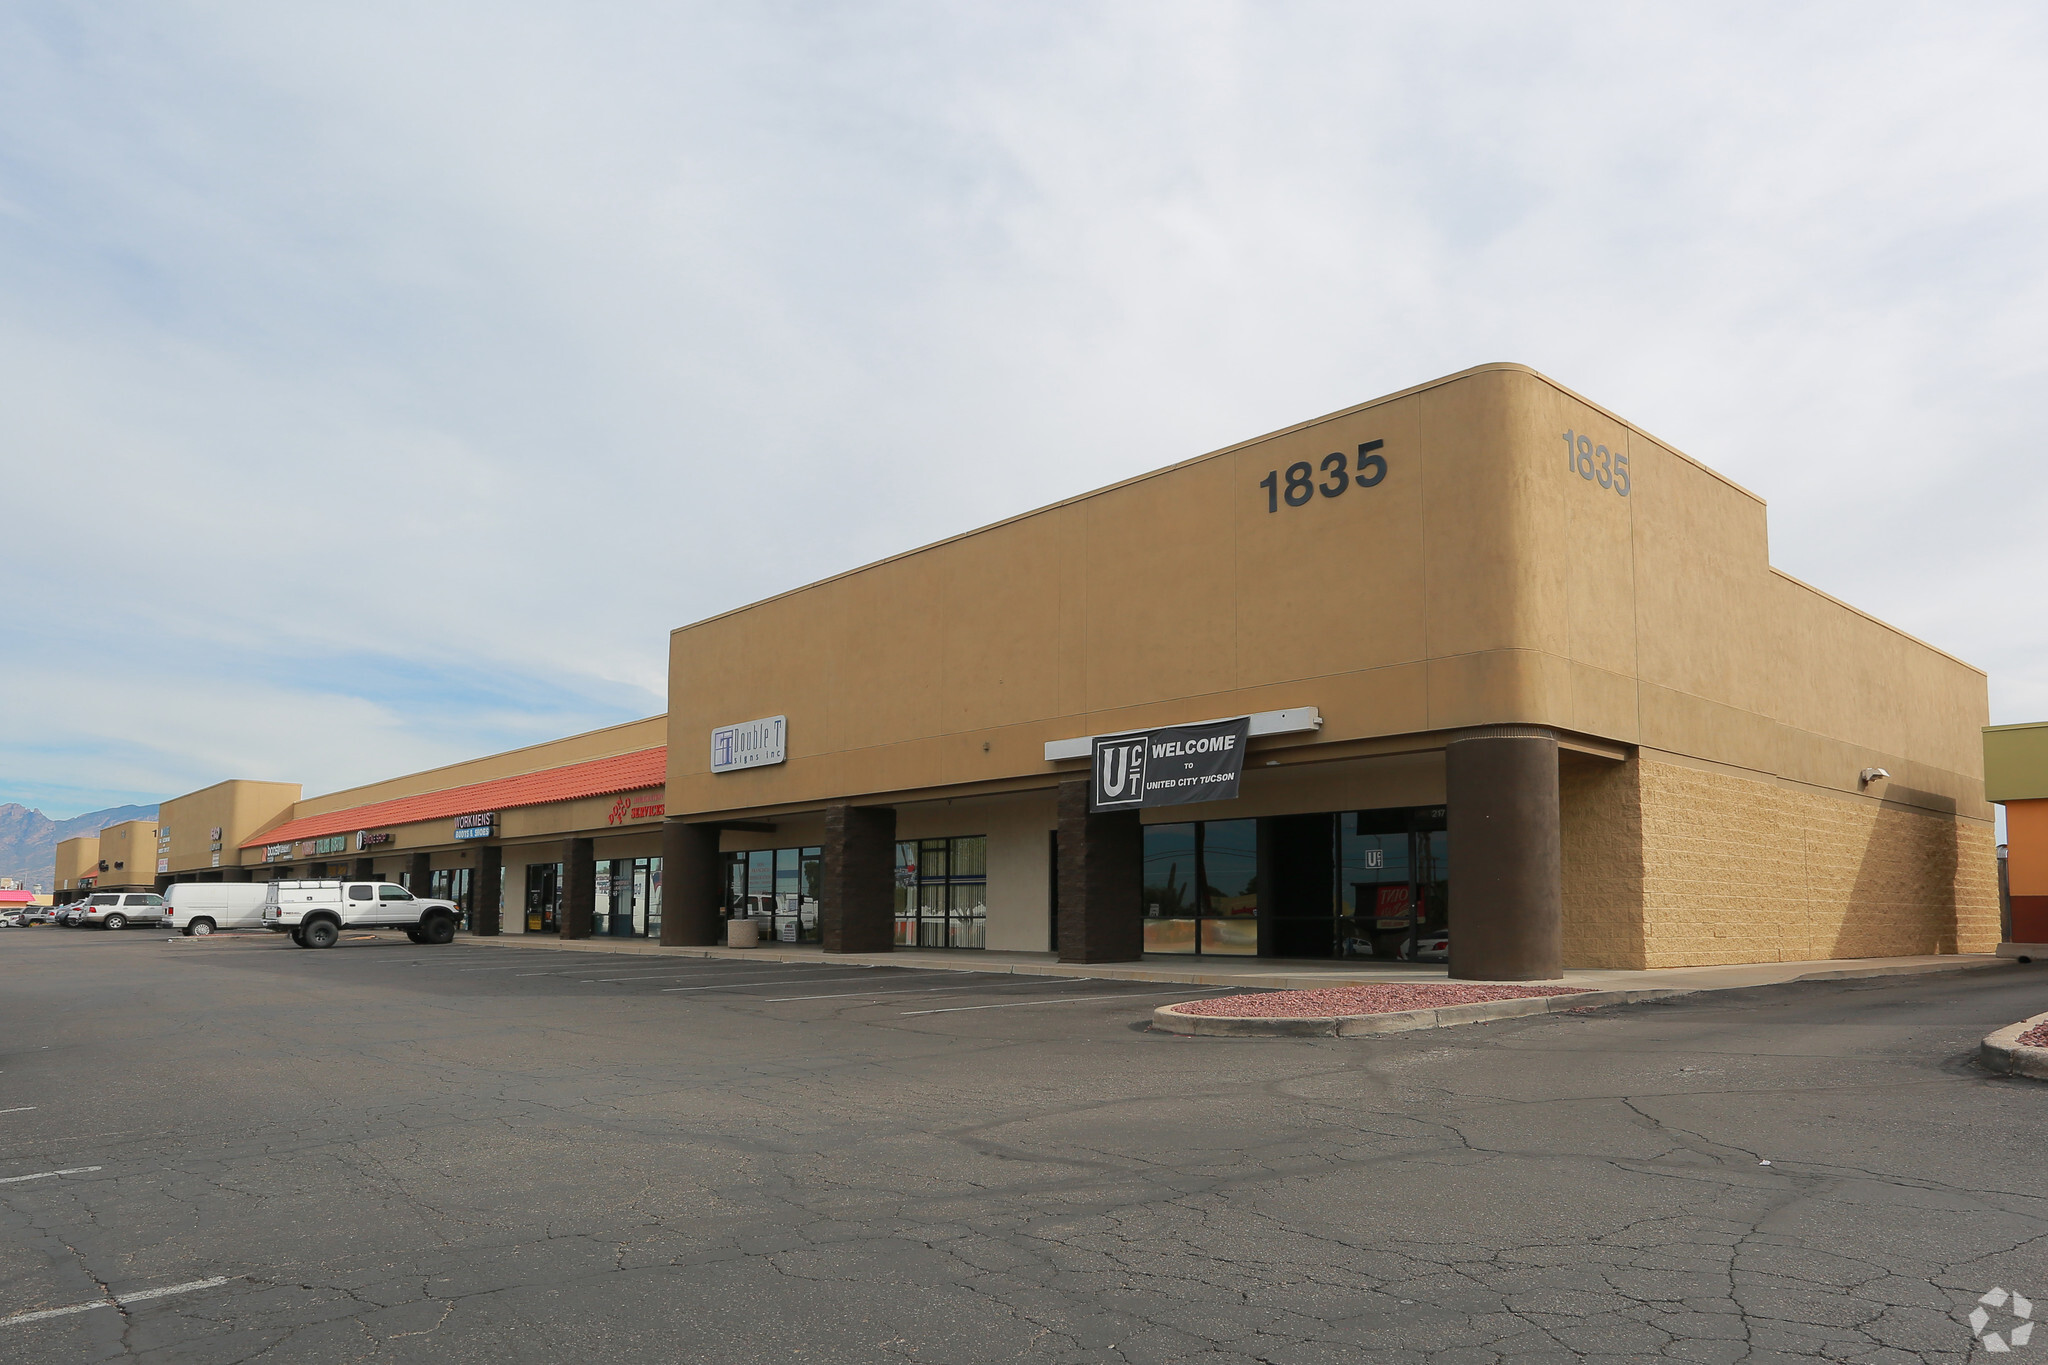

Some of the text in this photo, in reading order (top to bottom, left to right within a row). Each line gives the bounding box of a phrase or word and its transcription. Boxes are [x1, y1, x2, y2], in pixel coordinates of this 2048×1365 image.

[1561, 428, 1631, 497] 1835
[1259, 438, 1389, 514] 1835
[734, 719, 782, 753] Double T
[1151, 735, 1236, 759] WELCOME
[734, 750, 781, 764] signs inc
[1146, 772, 1235, 790] UNITED CITY TUCSON
[454, 812, 491, 828] WORKMENS
[631, 804, 665, 818] SERVICES
[455, 829, 469, 838] BOOTS
[474, 827, 489, 836] SHOES
